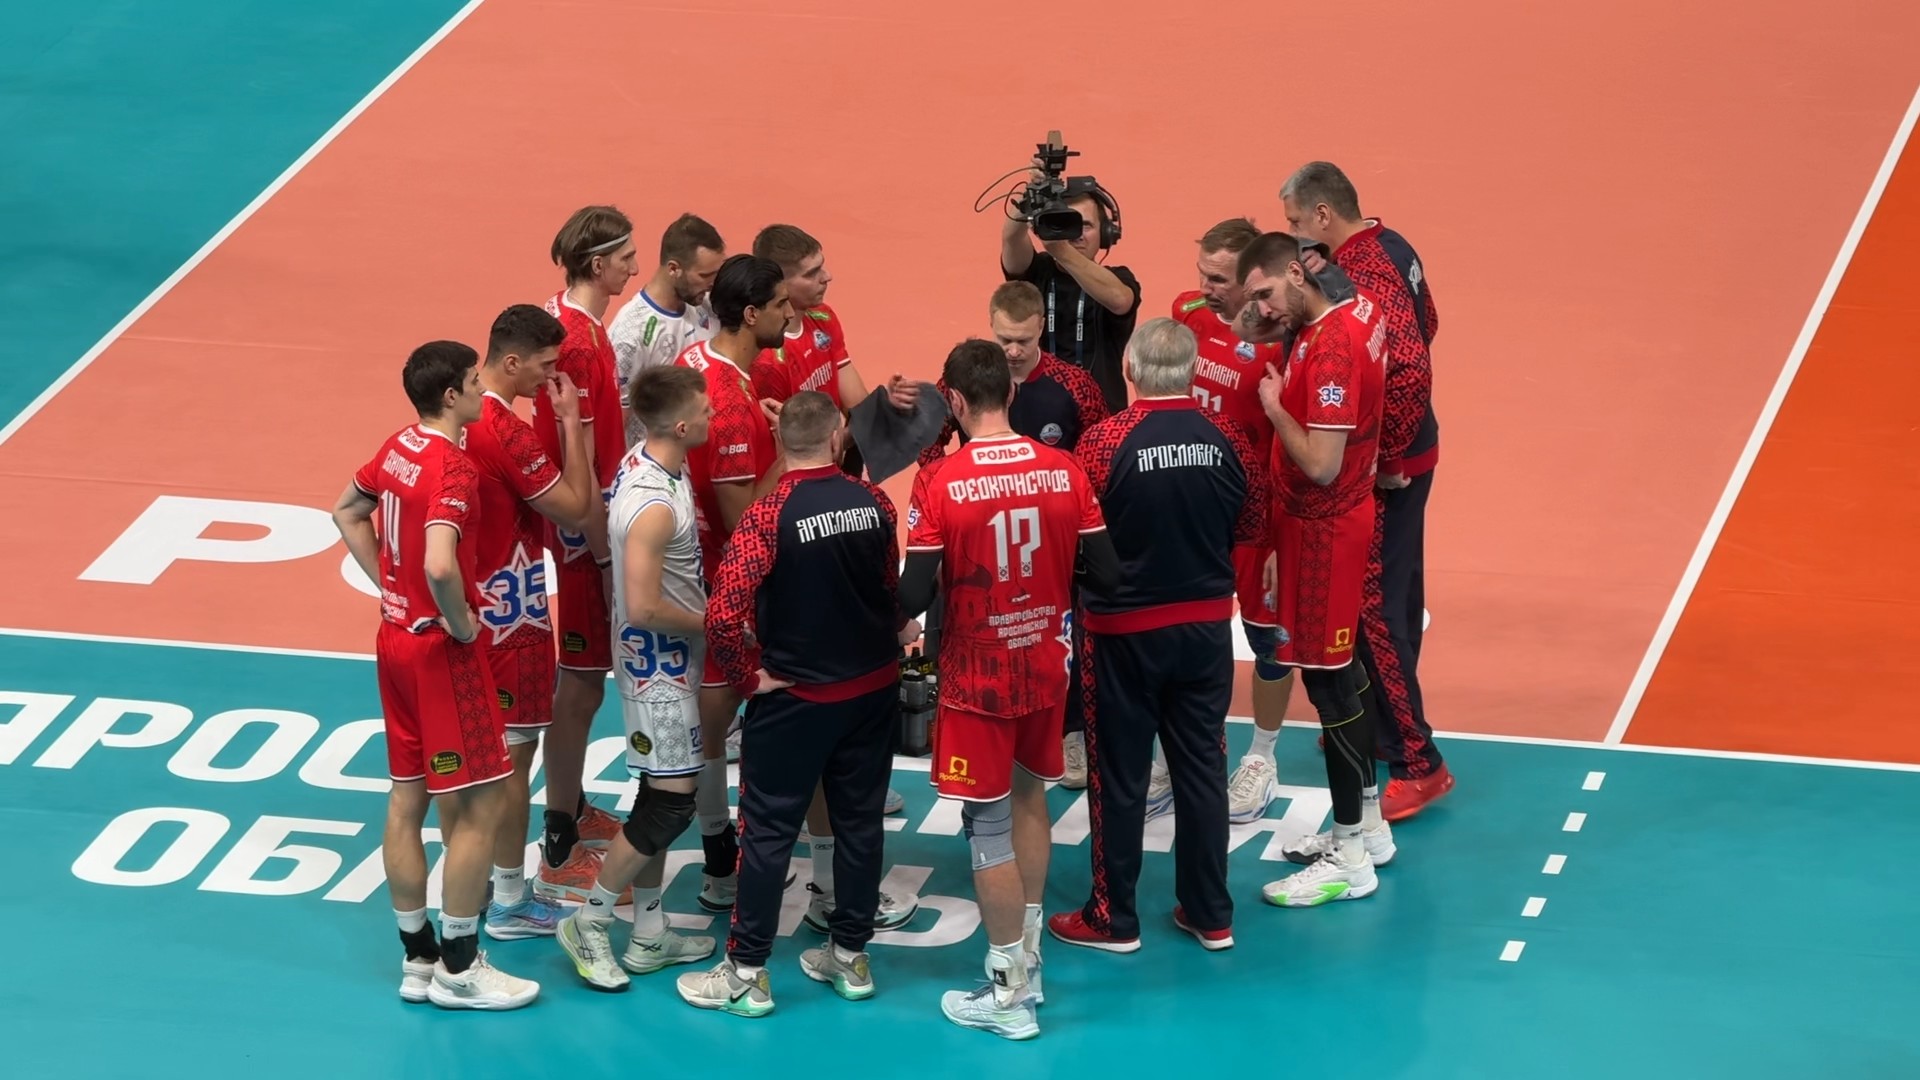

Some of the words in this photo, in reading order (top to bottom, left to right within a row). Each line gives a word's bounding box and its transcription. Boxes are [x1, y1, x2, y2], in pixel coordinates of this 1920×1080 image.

[1195, 355, 1241, 390] ОСЛАВИЧ
[1321, 388, 1342, 403] 35
[976, 446, 1030, 461] РОЛЬФ
[1137, 443, 1223, 472] ЯРОСЛАВИЧ
[947, 469, 1070, 504] ФЕОКТИСТОВ
[796, 506, 880, 543] ЯРОСЛАВИЧ
[988, 507, 1041, 582] 17
[485, 562, 548, 626] 35
[621, 626, 690, 678] 35
